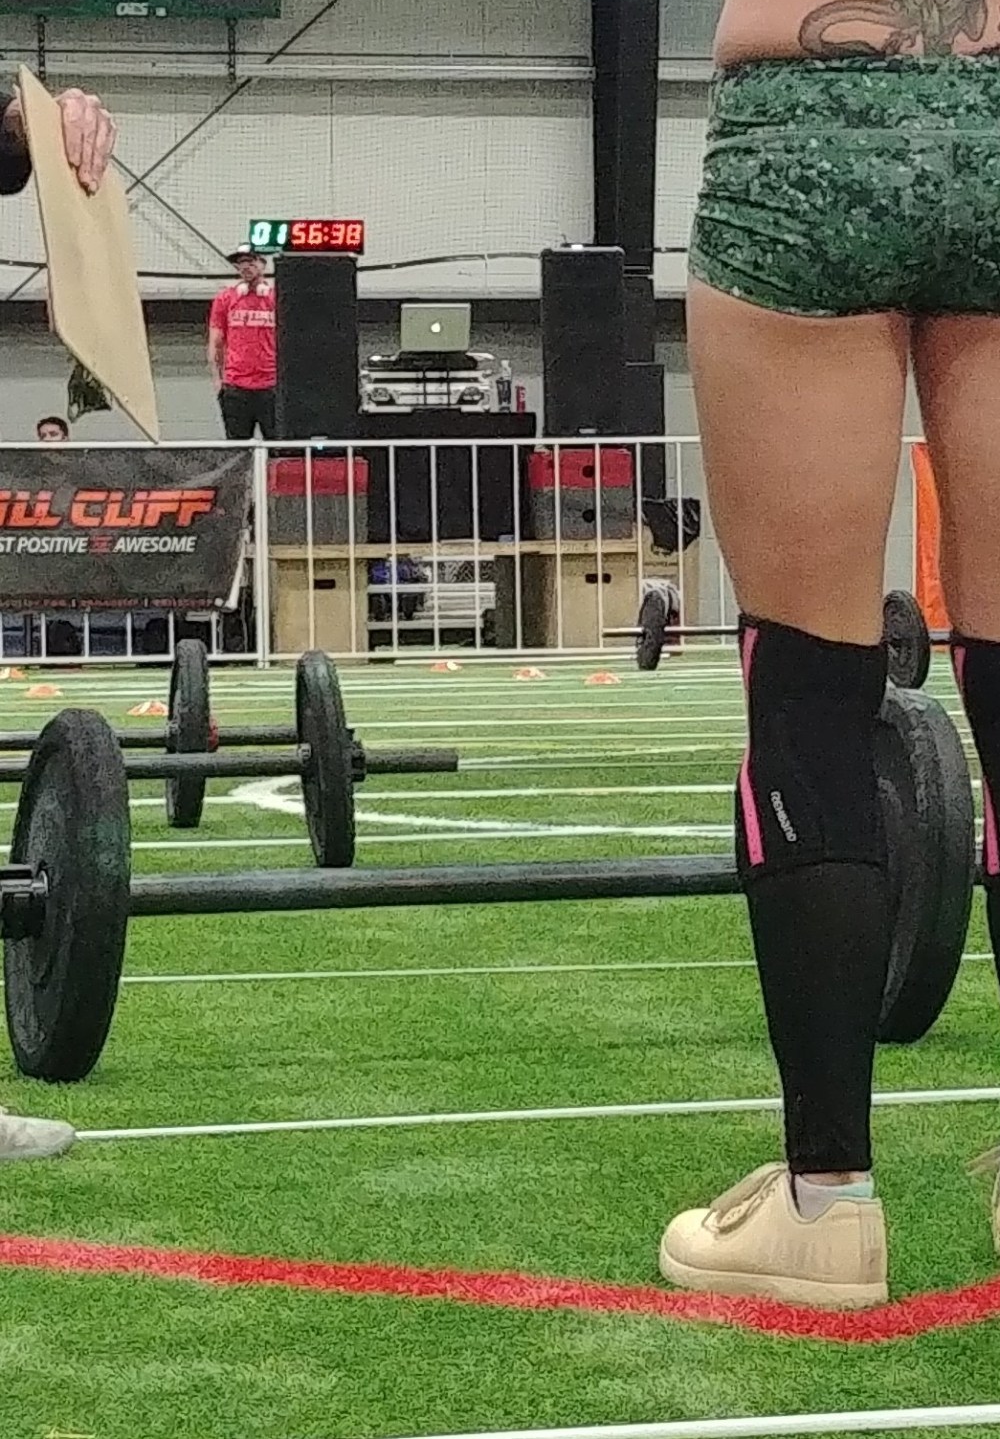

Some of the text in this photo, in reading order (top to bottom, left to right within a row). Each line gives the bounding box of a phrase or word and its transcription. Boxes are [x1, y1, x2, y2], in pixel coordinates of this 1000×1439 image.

[251, 221, 287, 246] 01
[0, 488, 216, 528] ILL CLIFF
[17, 536, 88, 554] POSITIVE
[113, 536, 196, 554] AWESOME
